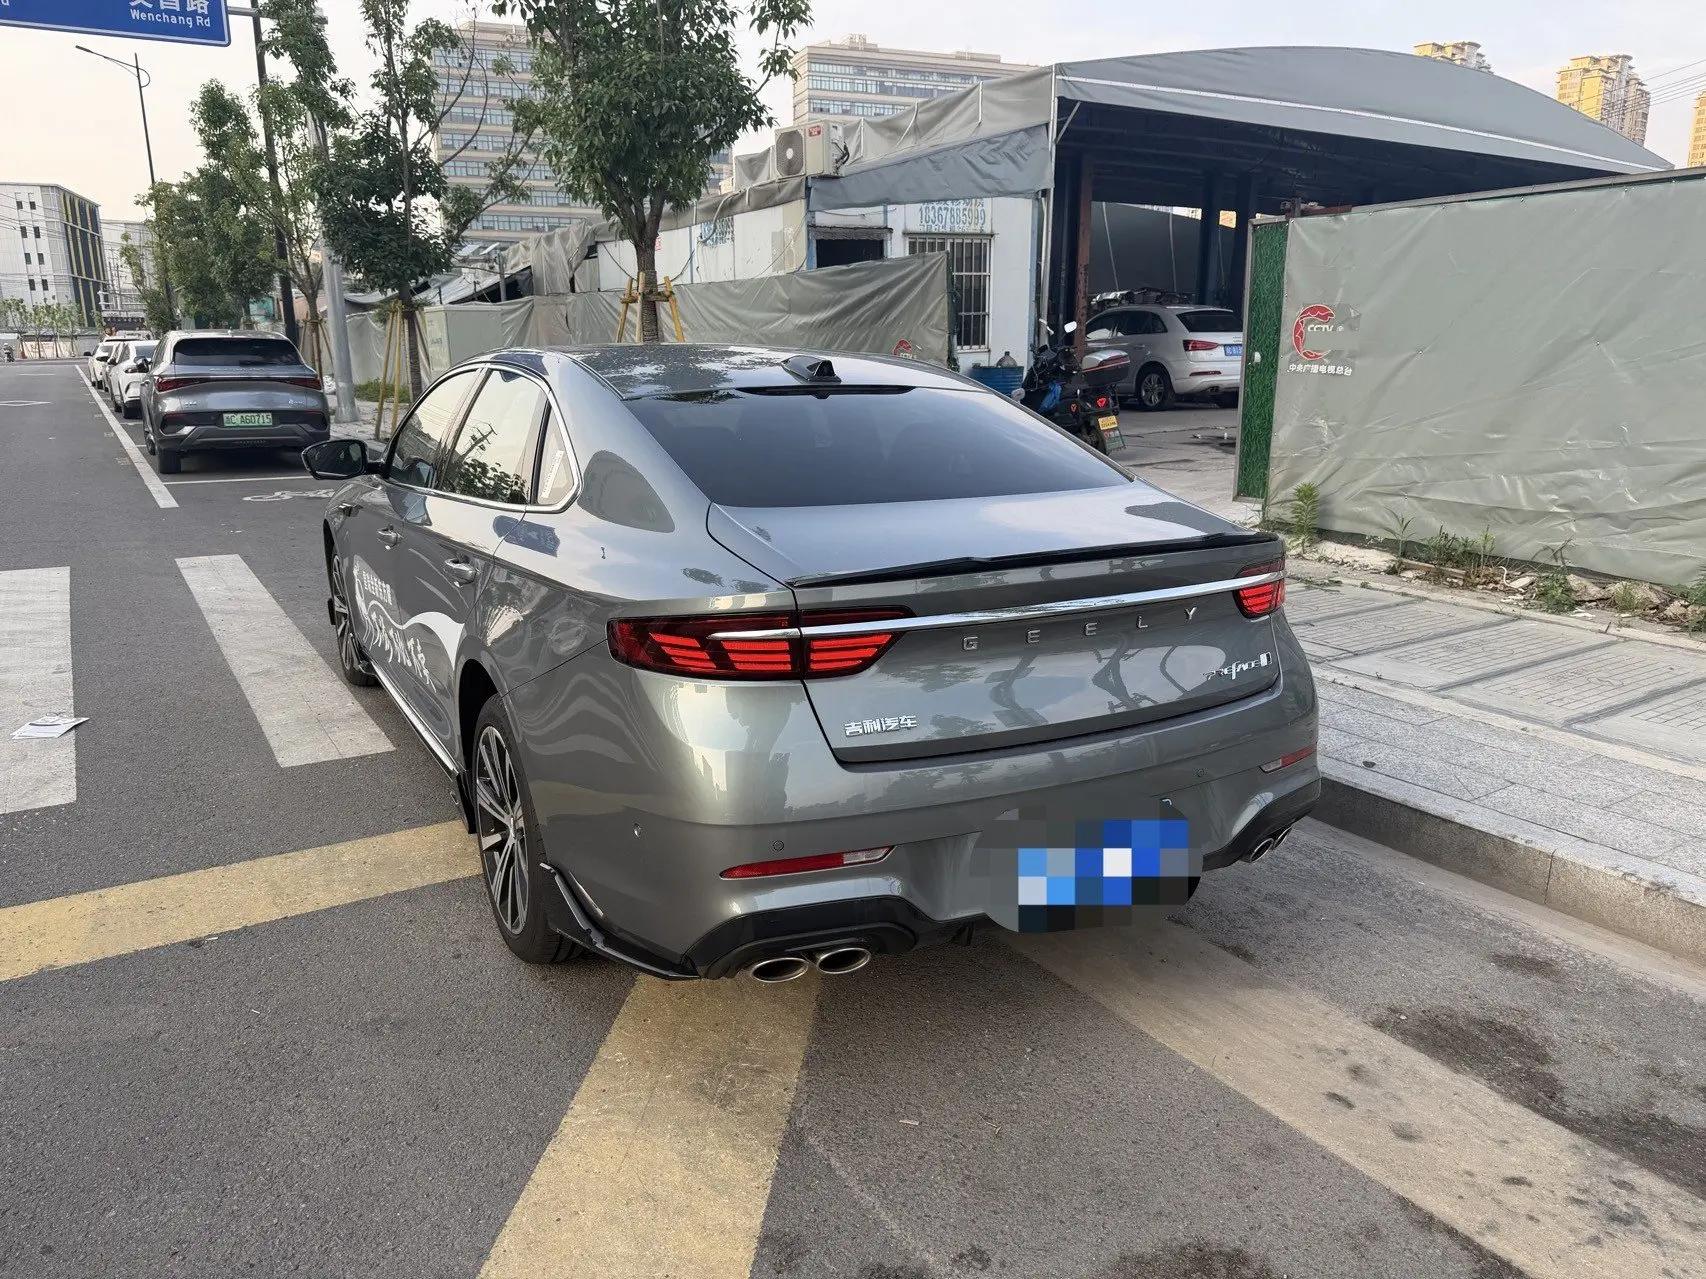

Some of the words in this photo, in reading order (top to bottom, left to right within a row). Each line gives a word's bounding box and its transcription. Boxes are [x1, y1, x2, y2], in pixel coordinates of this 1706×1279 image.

[130, 9, 193, 28] Wenchang
[196, 15, 211, 27] Rd
[1307, 324, 1334, 332] CCTV
[962, 606, 1198, 651] GEELY
[844, 715, 917, 737] 吉利汽车
